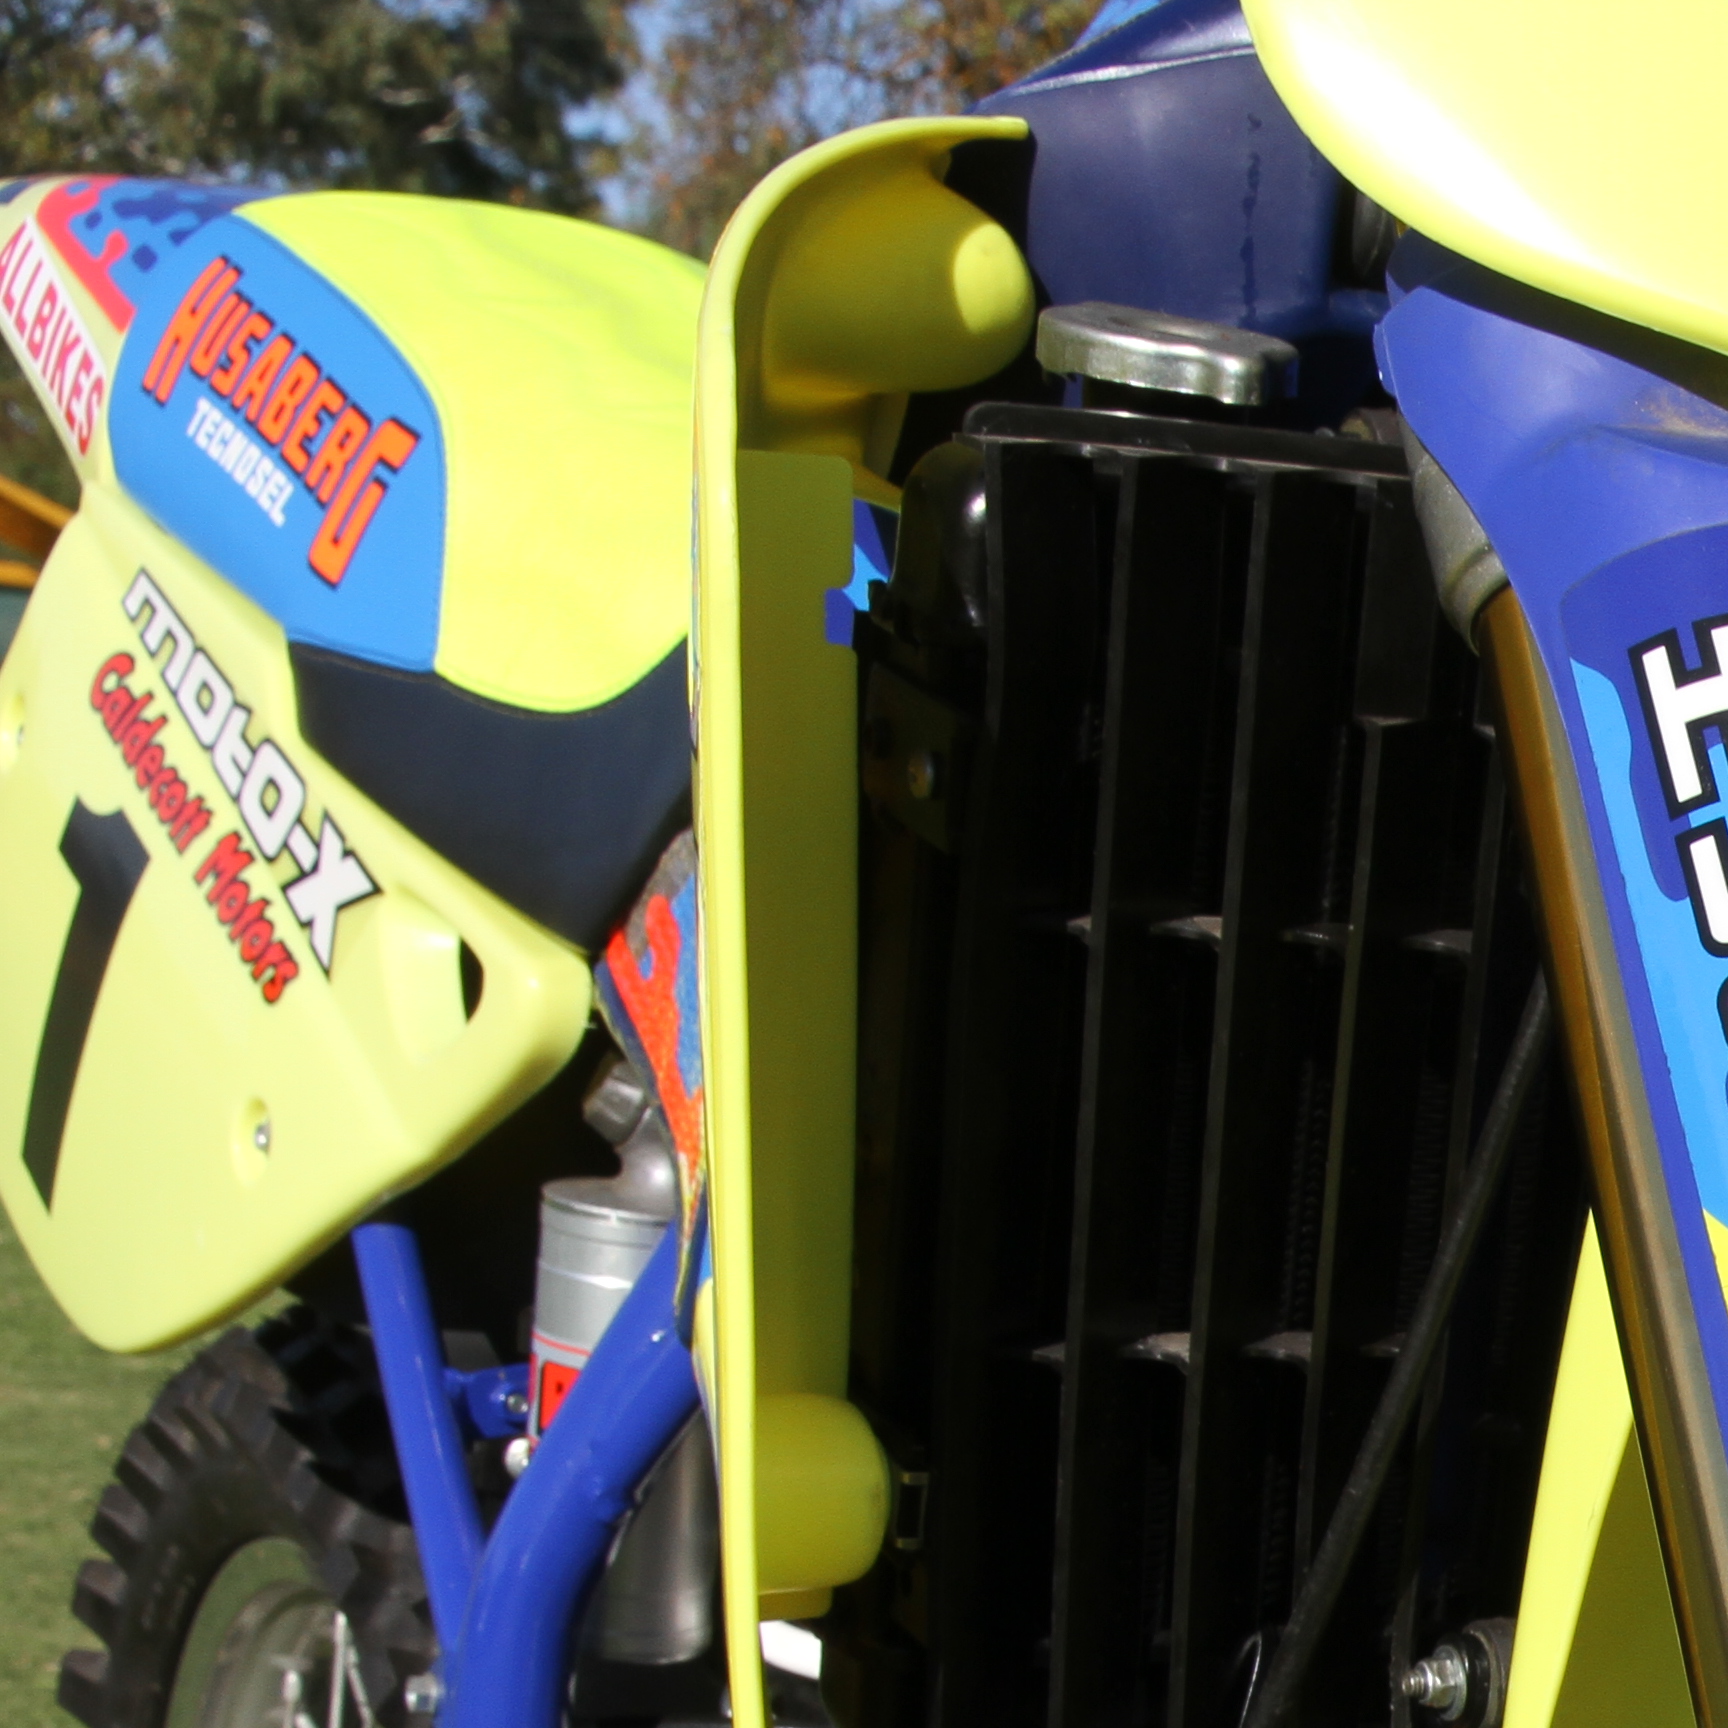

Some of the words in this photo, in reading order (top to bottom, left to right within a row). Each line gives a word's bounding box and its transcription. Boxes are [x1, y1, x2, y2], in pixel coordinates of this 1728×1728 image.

[142, 255, 422, 588] HUSABERG
[186, 396, 294, 527] TECNOSEL
[91, 652, 213, 856] Caldecott
[194, 829, 299, 1004] Motors
